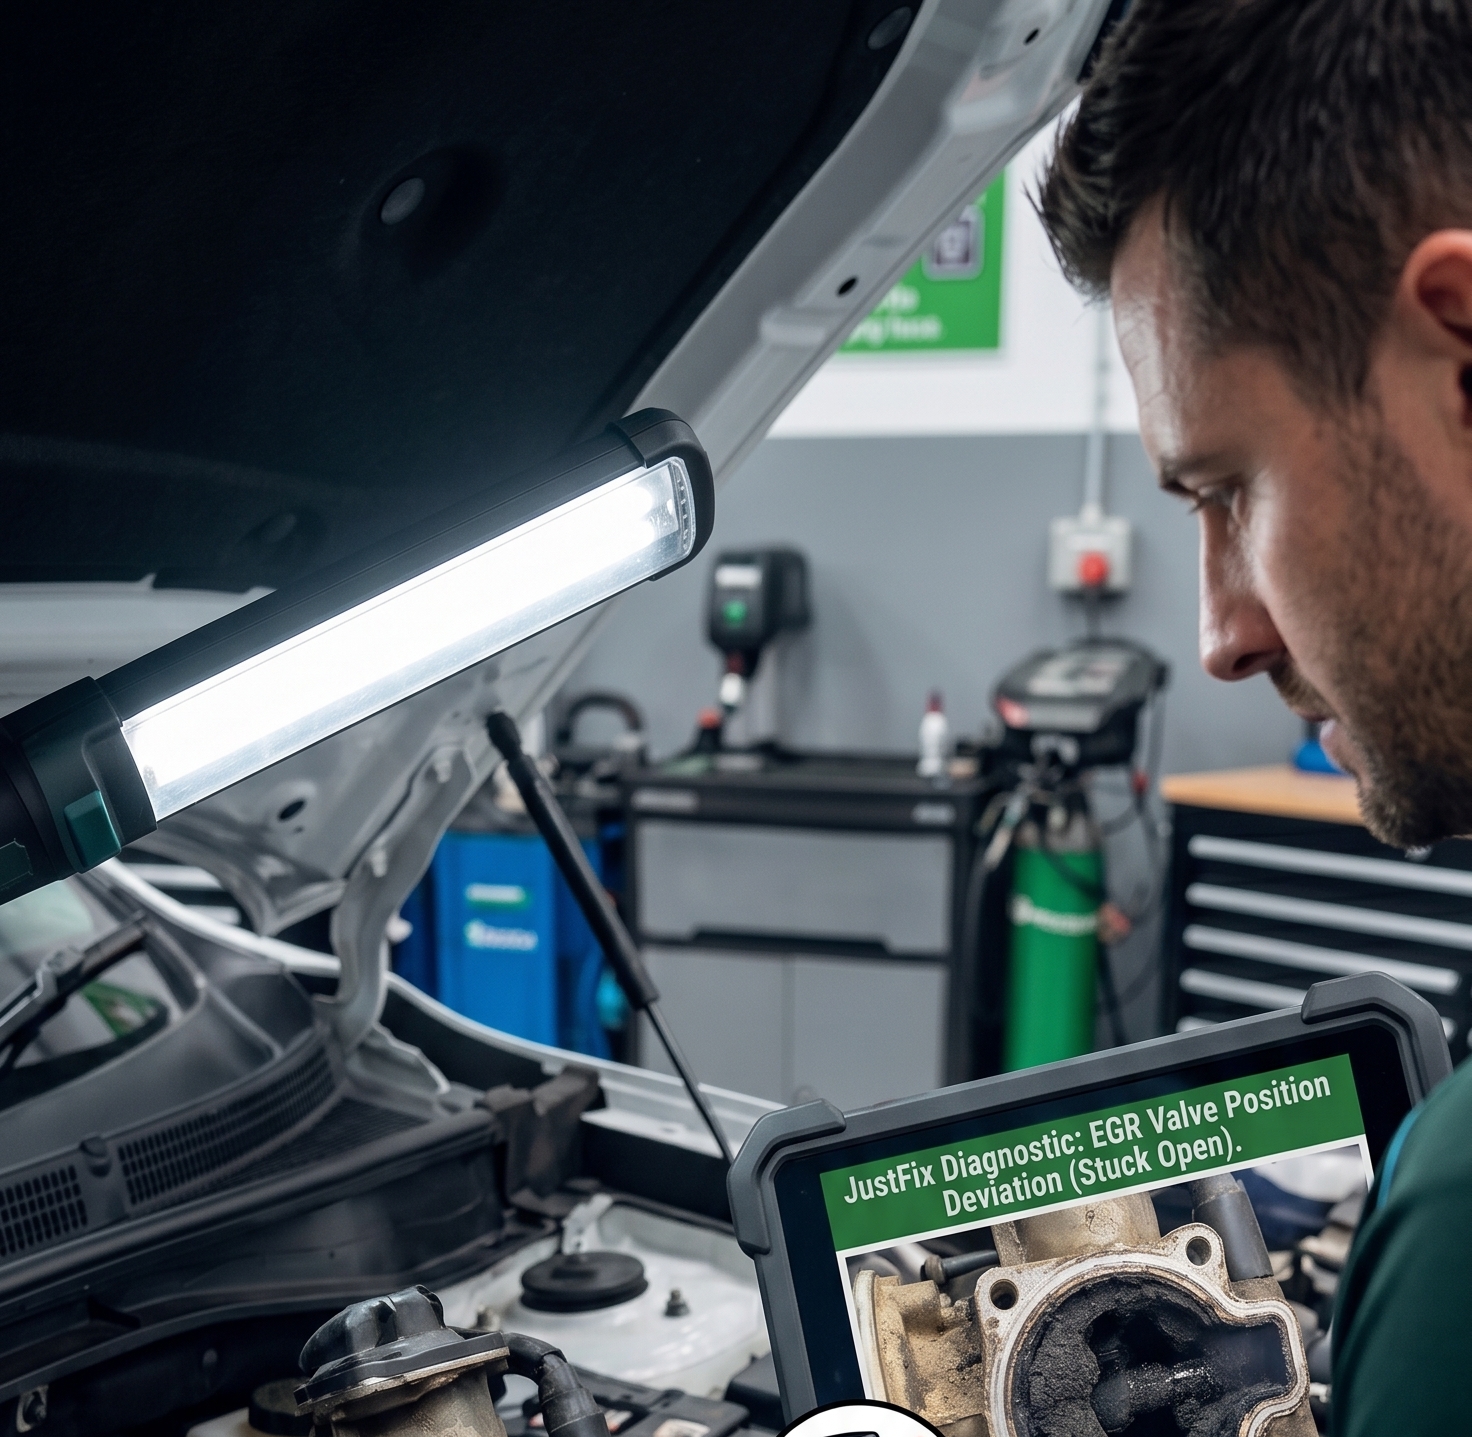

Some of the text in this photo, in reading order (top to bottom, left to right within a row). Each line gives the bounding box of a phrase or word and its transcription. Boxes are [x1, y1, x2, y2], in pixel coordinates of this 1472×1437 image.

[844, 1075, 1331, 1204] JustFix Diagnostic: EGR Valve Position
[942, 1125, 1242, 1217] Deviation (Stuck Open).
